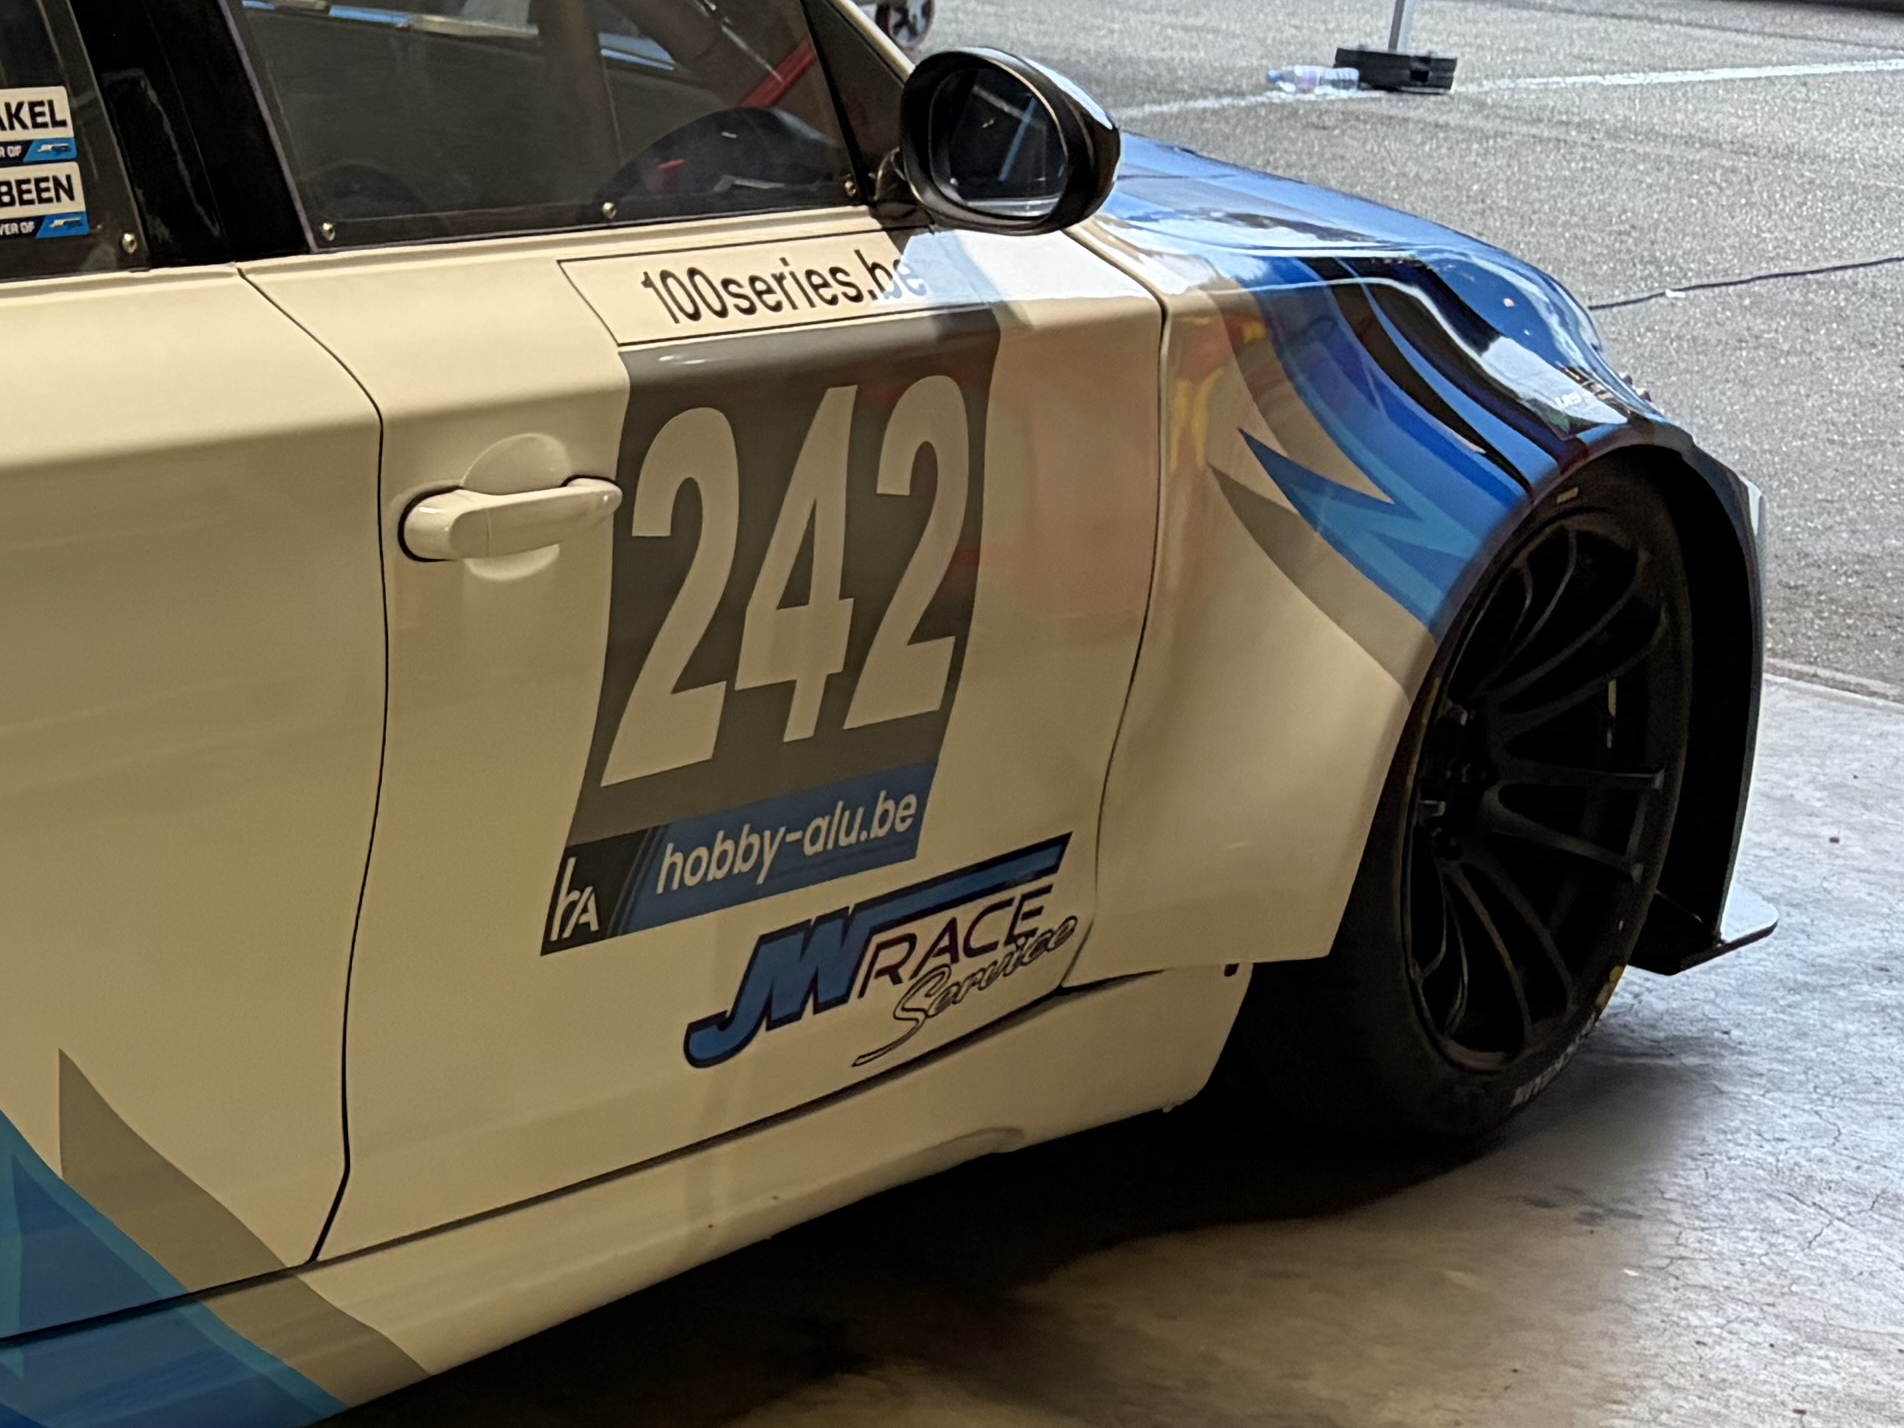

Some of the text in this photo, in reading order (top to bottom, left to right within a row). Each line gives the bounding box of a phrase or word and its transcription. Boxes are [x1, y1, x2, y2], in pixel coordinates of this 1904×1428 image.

[7, 145, 22, 157] OF
[20, 220, 36, 233] OF
[641, 249, 928, 324] 100series.be
[600, 374, 970, 788] 242
[656, 789, 917, 895] hobby-alu.be
[852, 915, 1079, 1068] Service
[858, 883, 1054, 999] RACE
